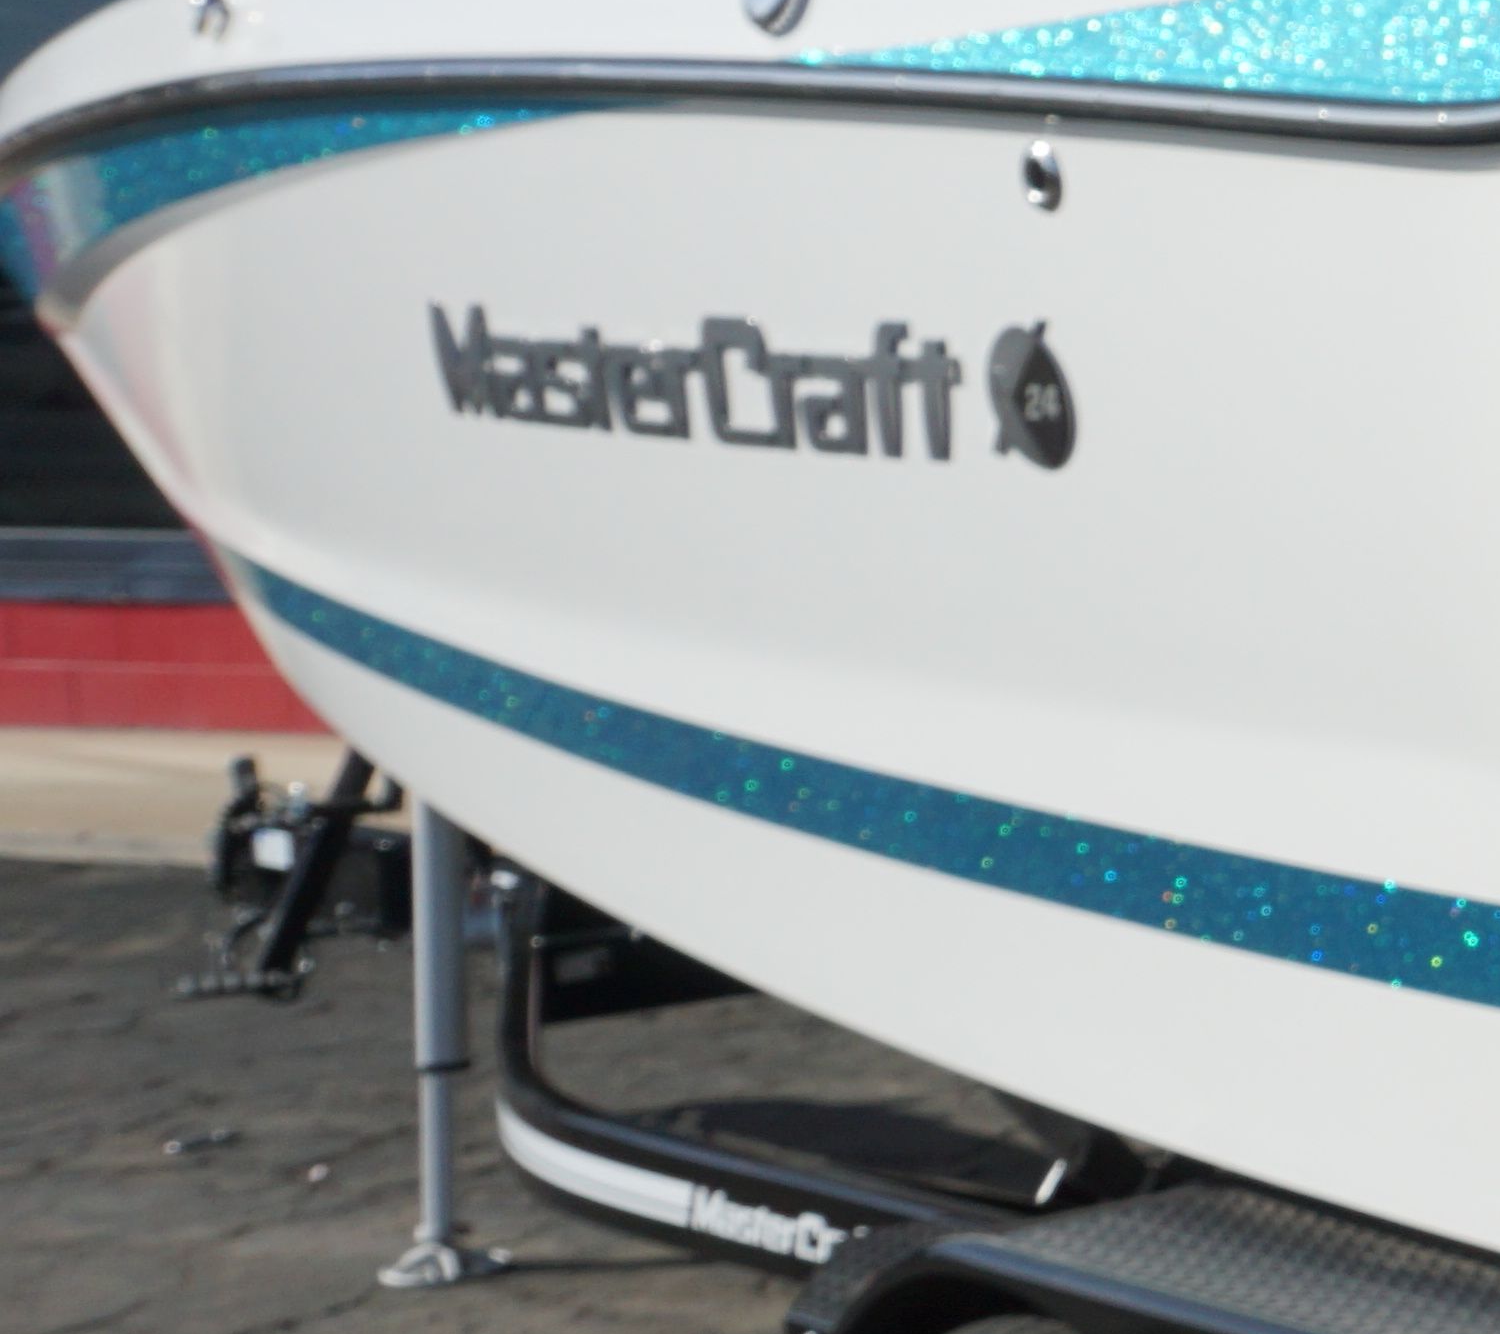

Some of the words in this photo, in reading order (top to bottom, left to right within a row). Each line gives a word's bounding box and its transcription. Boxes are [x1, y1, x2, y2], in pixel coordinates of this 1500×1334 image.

[430, 304, 961, 460] MasterCraft
[1023, 383, 1060, 421] 24
[691, 1185, 870, 1264] MasterCr
